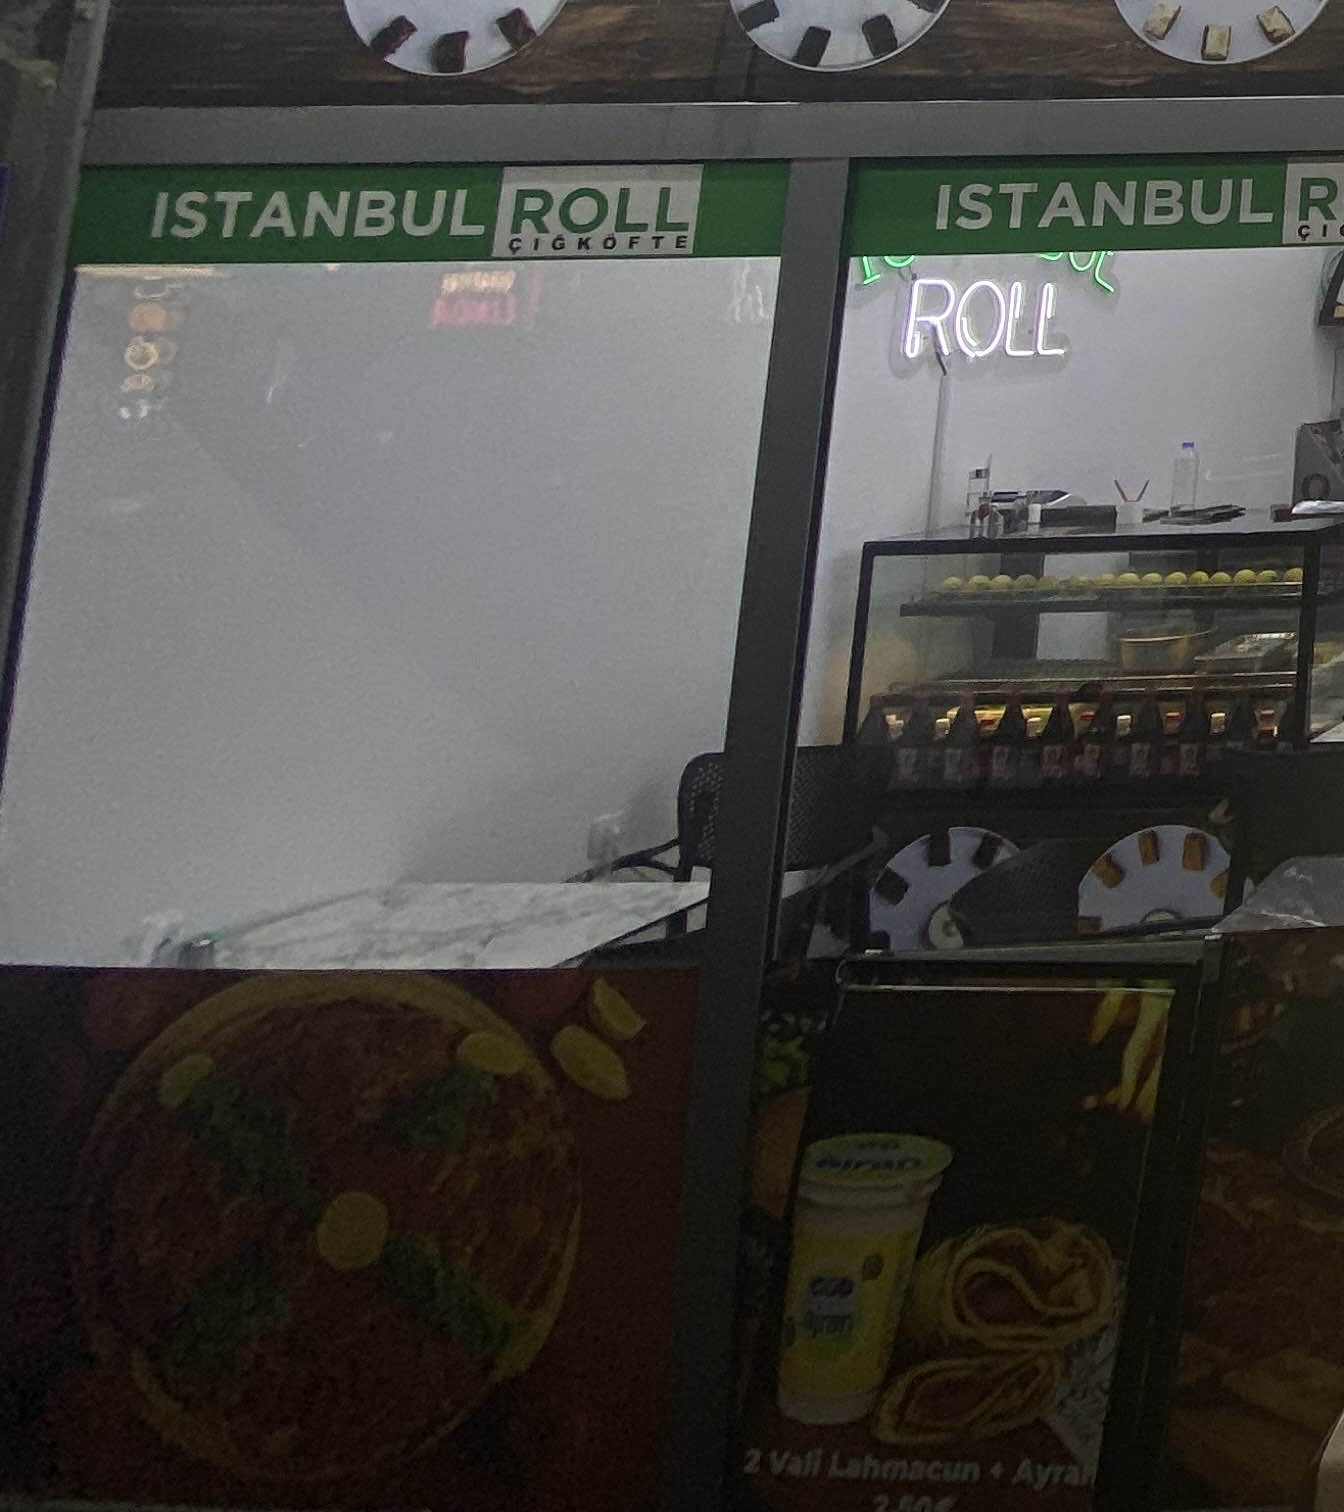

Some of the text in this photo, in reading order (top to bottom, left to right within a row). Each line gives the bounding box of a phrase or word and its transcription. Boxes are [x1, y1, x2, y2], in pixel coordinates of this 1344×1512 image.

[151, 187, 690, 239] ISTANBUL ROLL
[935, 178, 1275, 230] ISTANBUL
[905, 278, 1065, 359] ROLL
[743, 1448, 763, 1475] 2
[827, 1451, 981, 1482] Lahmacun
